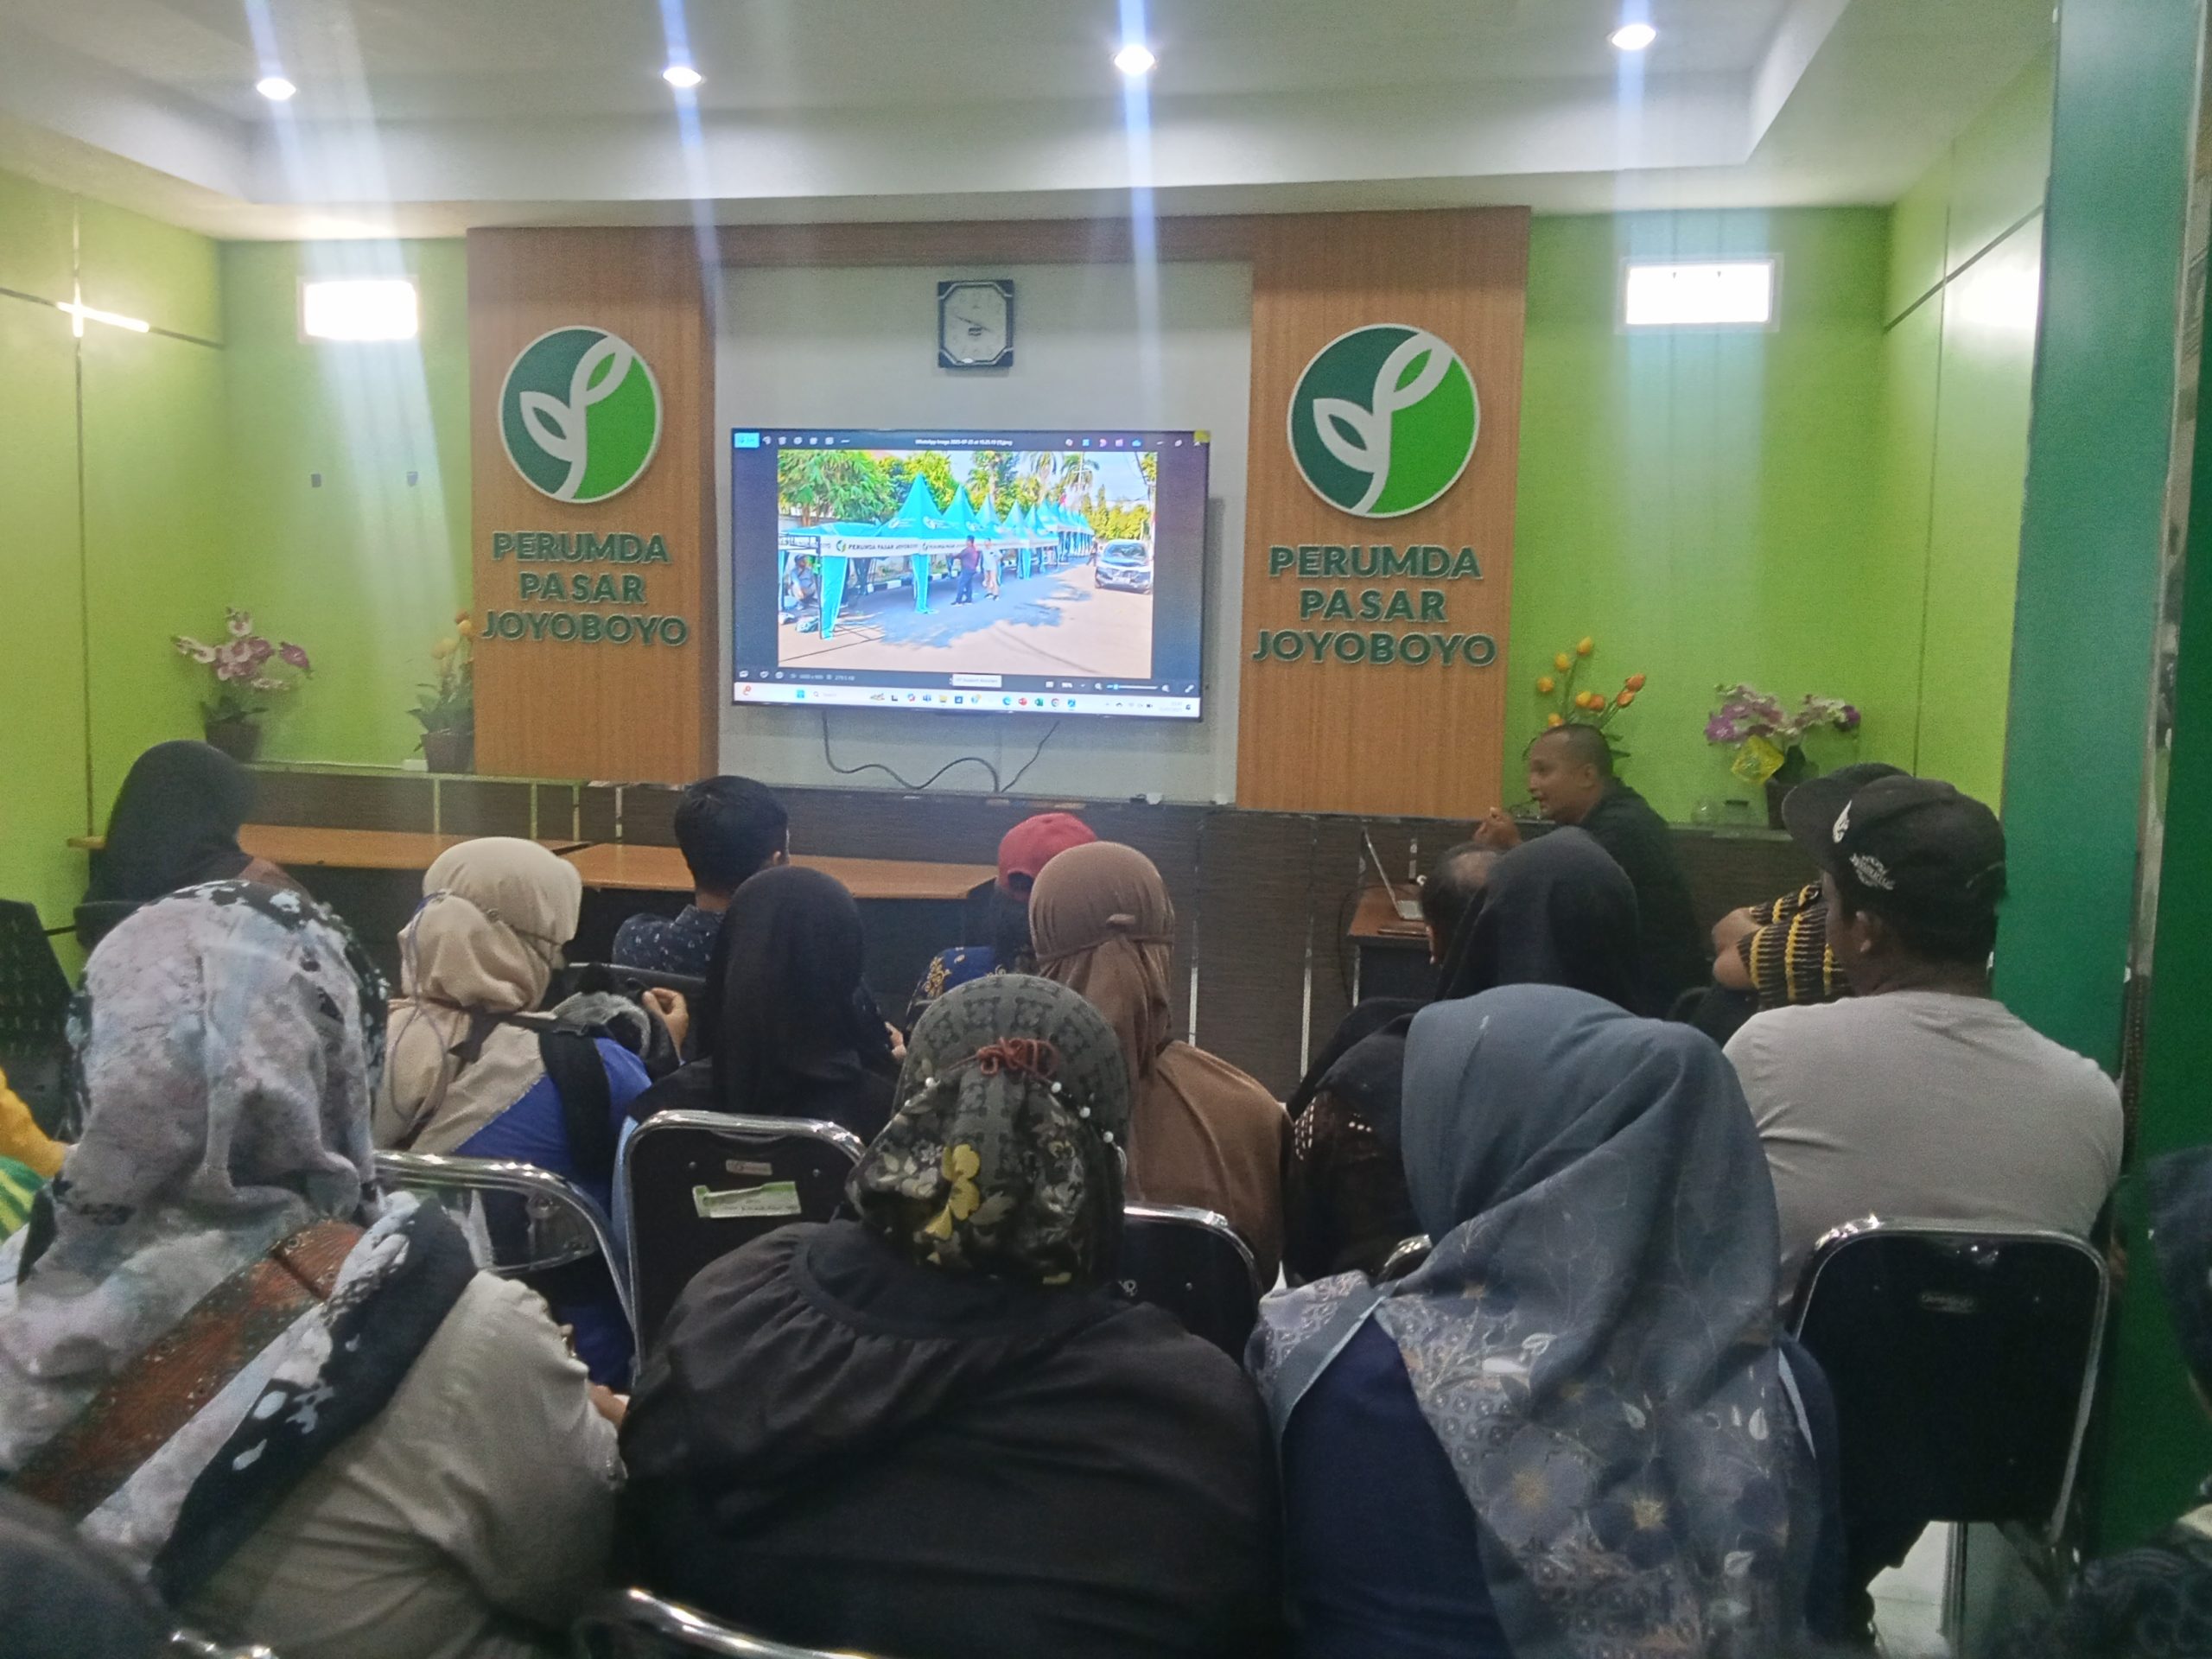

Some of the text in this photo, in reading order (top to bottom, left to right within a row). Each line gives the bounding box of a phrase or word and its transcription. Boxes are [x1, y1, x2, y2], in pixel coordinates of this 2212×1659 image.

[492, 531, 671, 563] PERUMDA
[1268, 544, 1484, 580] PERUMDA
[518, 571, 648, 606] PASAR
[1300, 588, 1448, 622] PASAR
[480, 610, 688, 647] JOYOBOYO
[1252, 629, 1497, 667] JOYOBOYO
